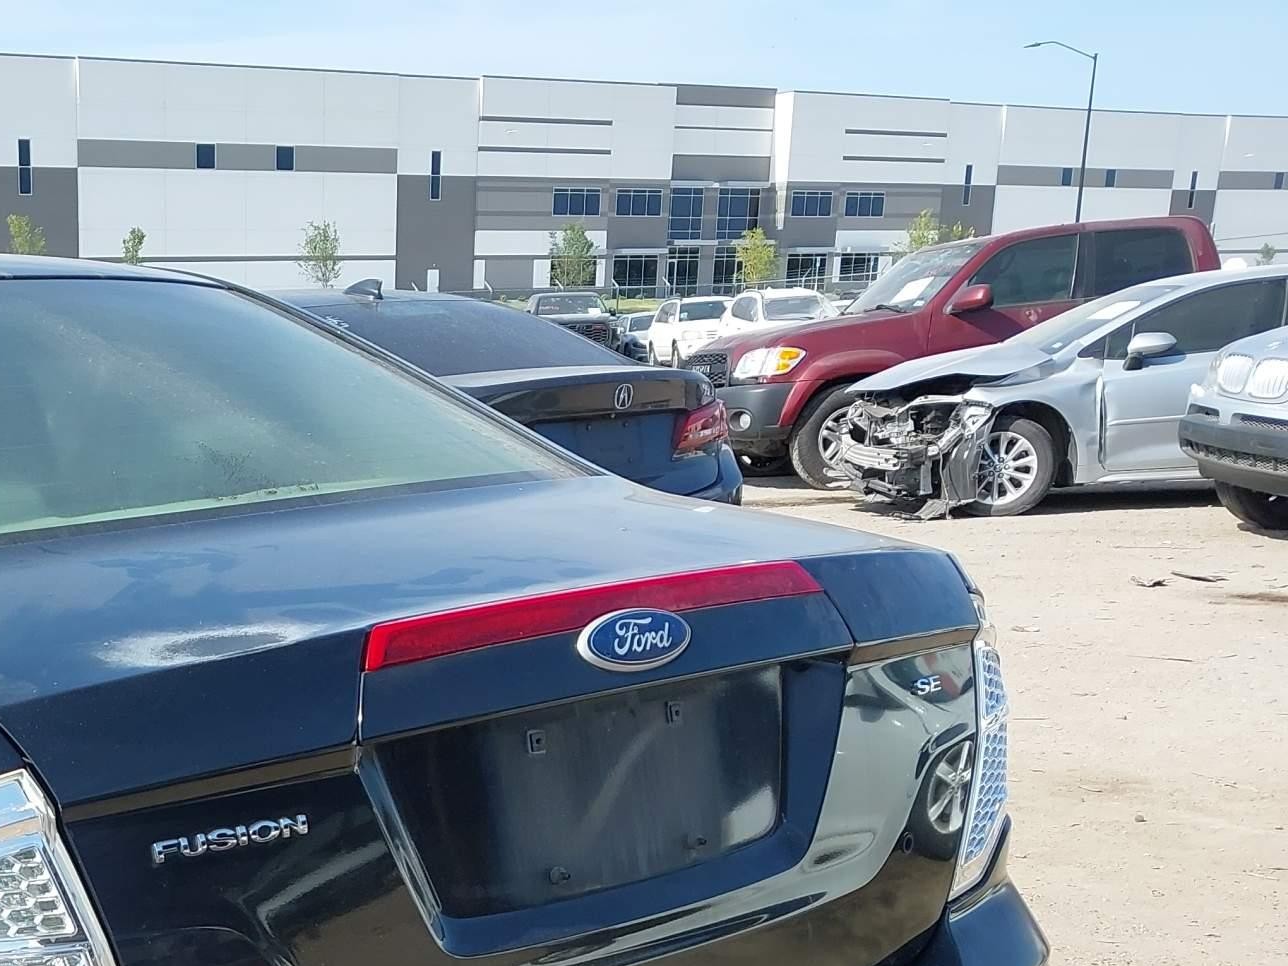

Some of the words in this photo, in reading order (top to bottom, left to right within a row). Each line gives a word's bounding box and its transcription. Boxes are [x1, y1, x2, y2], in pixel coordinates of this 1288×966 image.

[614, 617, 672, 655] Ford
[916, 675, 943, 695] SE
[152, 814, 309, 865] FUSION
